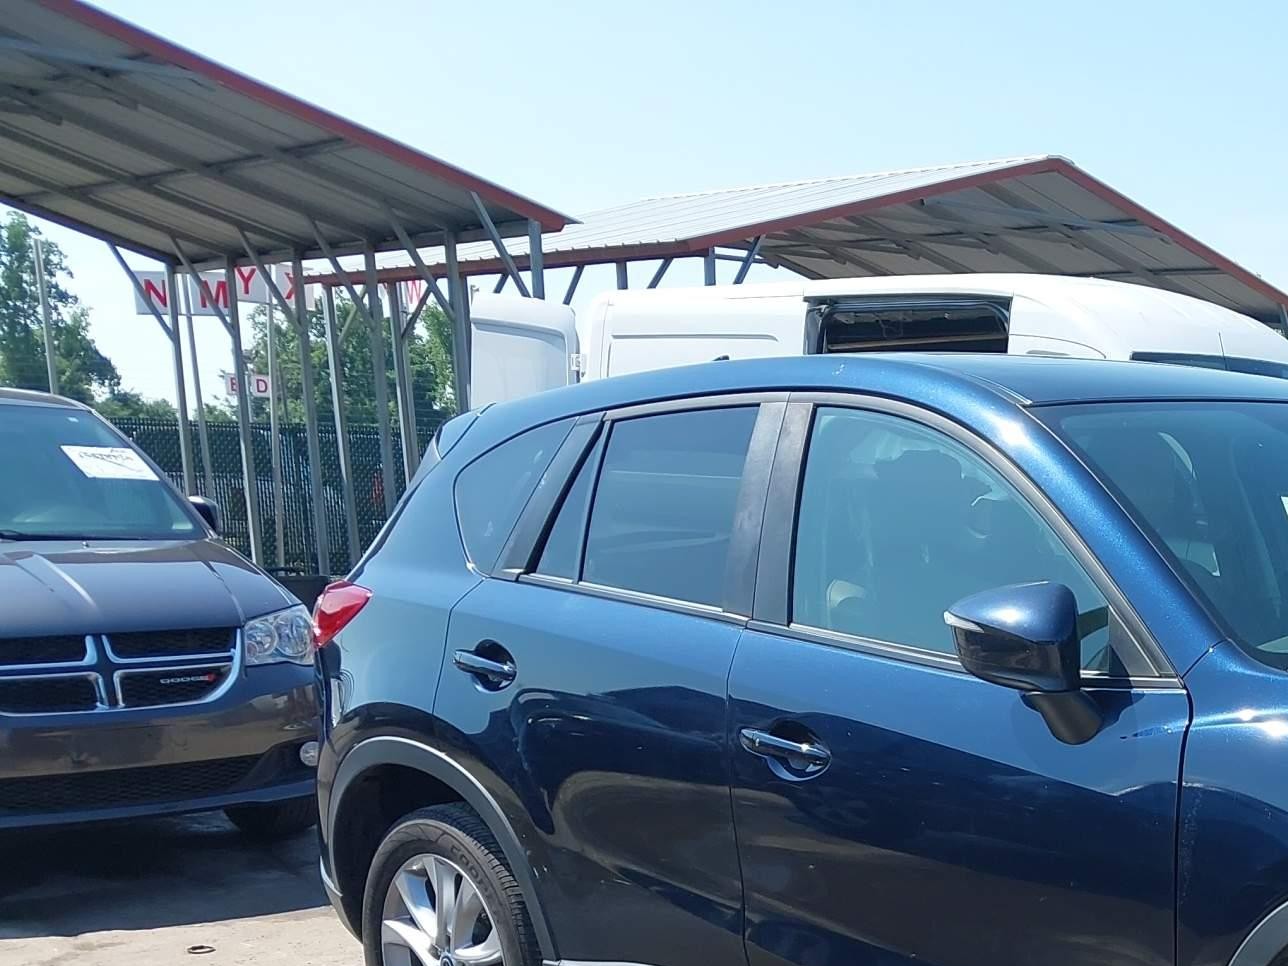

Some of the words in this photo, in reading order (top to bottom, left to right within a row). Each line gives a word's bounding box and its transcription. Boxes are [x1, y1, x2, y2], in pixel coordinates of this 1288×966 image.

[143, 278, 167, 308] N
[201, 279, 229, 308] M
[236, 266, 256, 295] Y
[256, 378, 268, 393] D
